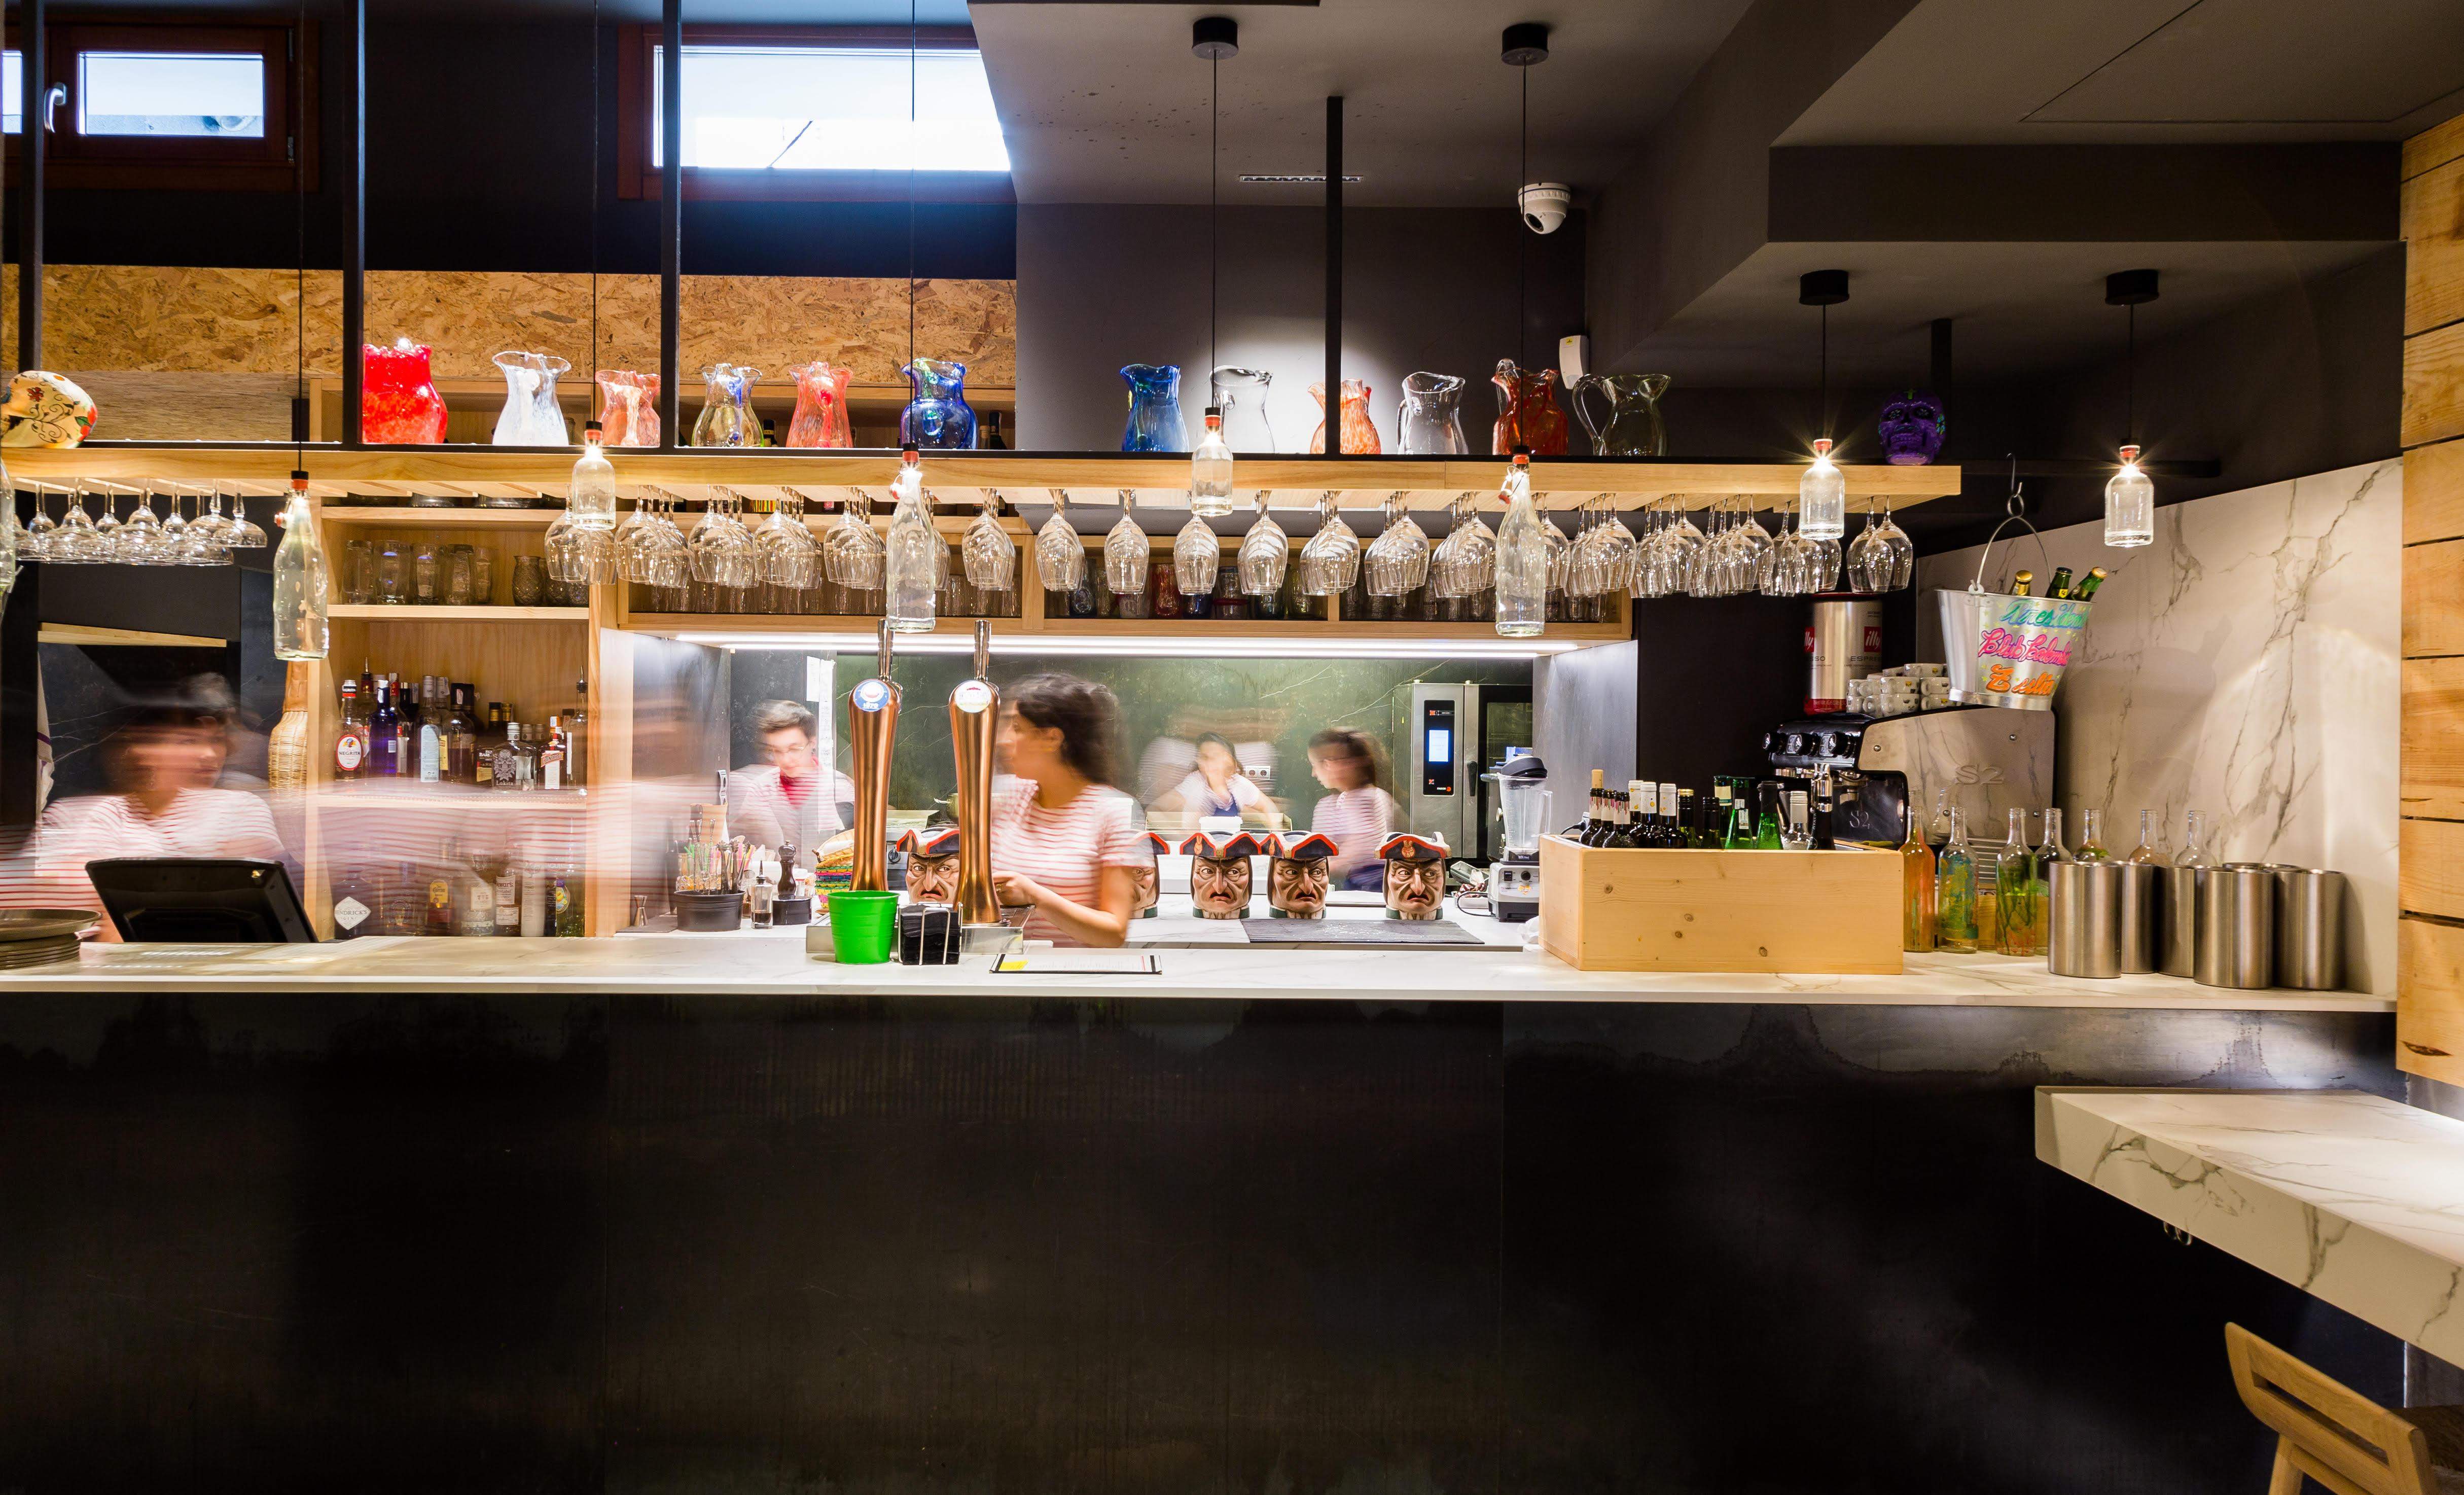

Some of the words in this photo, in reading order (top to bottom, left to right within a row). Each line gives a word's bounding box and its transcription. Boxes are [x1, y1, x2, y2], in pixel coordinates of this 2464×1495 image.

[1866, 630, 1881, 650] illy
[1955, 763, 2004, 786] S2
[1849, 810, 1870, 830] S2
